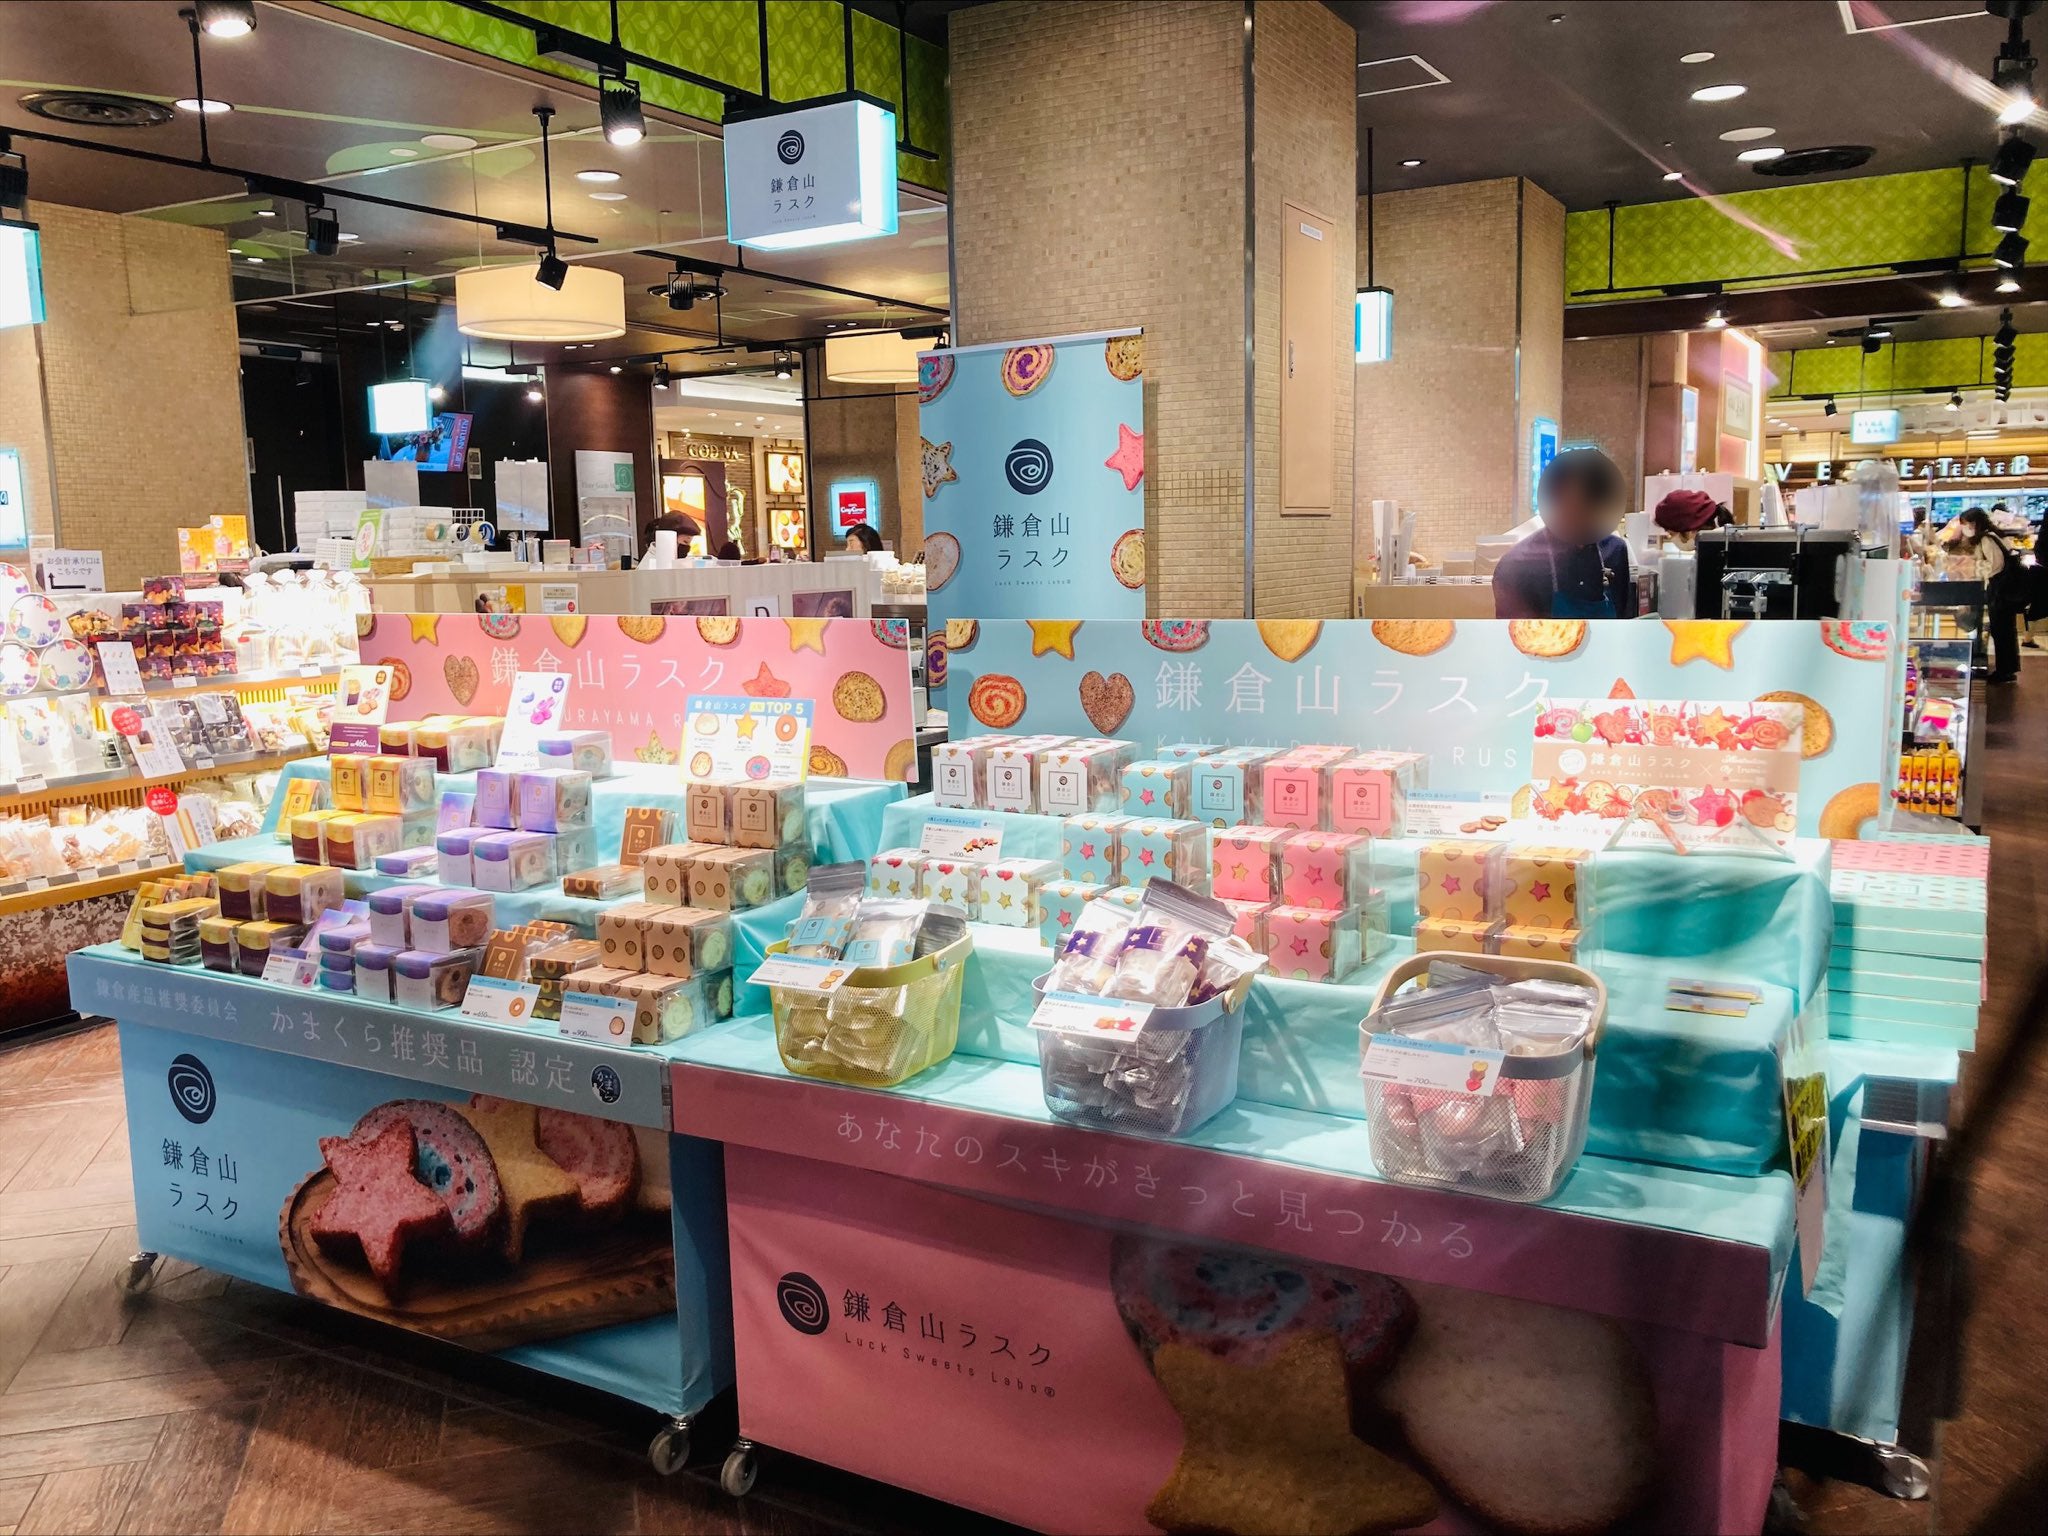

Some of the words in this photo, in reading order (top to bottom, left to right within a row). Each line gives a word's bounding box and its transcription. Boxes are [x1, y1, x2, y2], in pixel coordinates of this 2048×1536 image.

[771, 173, 815, 194] 鎌倉山
[773, 195, 814, 214] ラスク
[687, 443, 739, 459] GODVA
[993, 512, 1070, 538] 鎌倉山
[998, 547, 1068, 570] ラスク
[57, 567, 93, 576] こちらです
[490, 646, 725, 692] 鎌倉山ラスク
[1155, 660, 1551, 719] 鎌倉山ラスク
[495, 704, 655, 728] KURAYAMA
[766, 702, 793, 714] TOP
[795, 702, 805, 714] 5
[1453, 746, 1517, 769] RUS
[270, 1005, 483, 1077] かまくら推奨品
[510, 1048, 576, 1094] 認定
[1414, 1076, 1430, 1085] 700
[162, 1137, 238, 1184] 鎌倉山
[837, 1109, 1475, 1260] あなたのスキがきっと見つかる
[169, 1182, 238, 1220] ラスク
[842, 1288, 1051, 1367] 鎌倉山ラスク
[845, 1331, 888, 1354] Luck
[902, 1346, 975, 1377] Sweets
